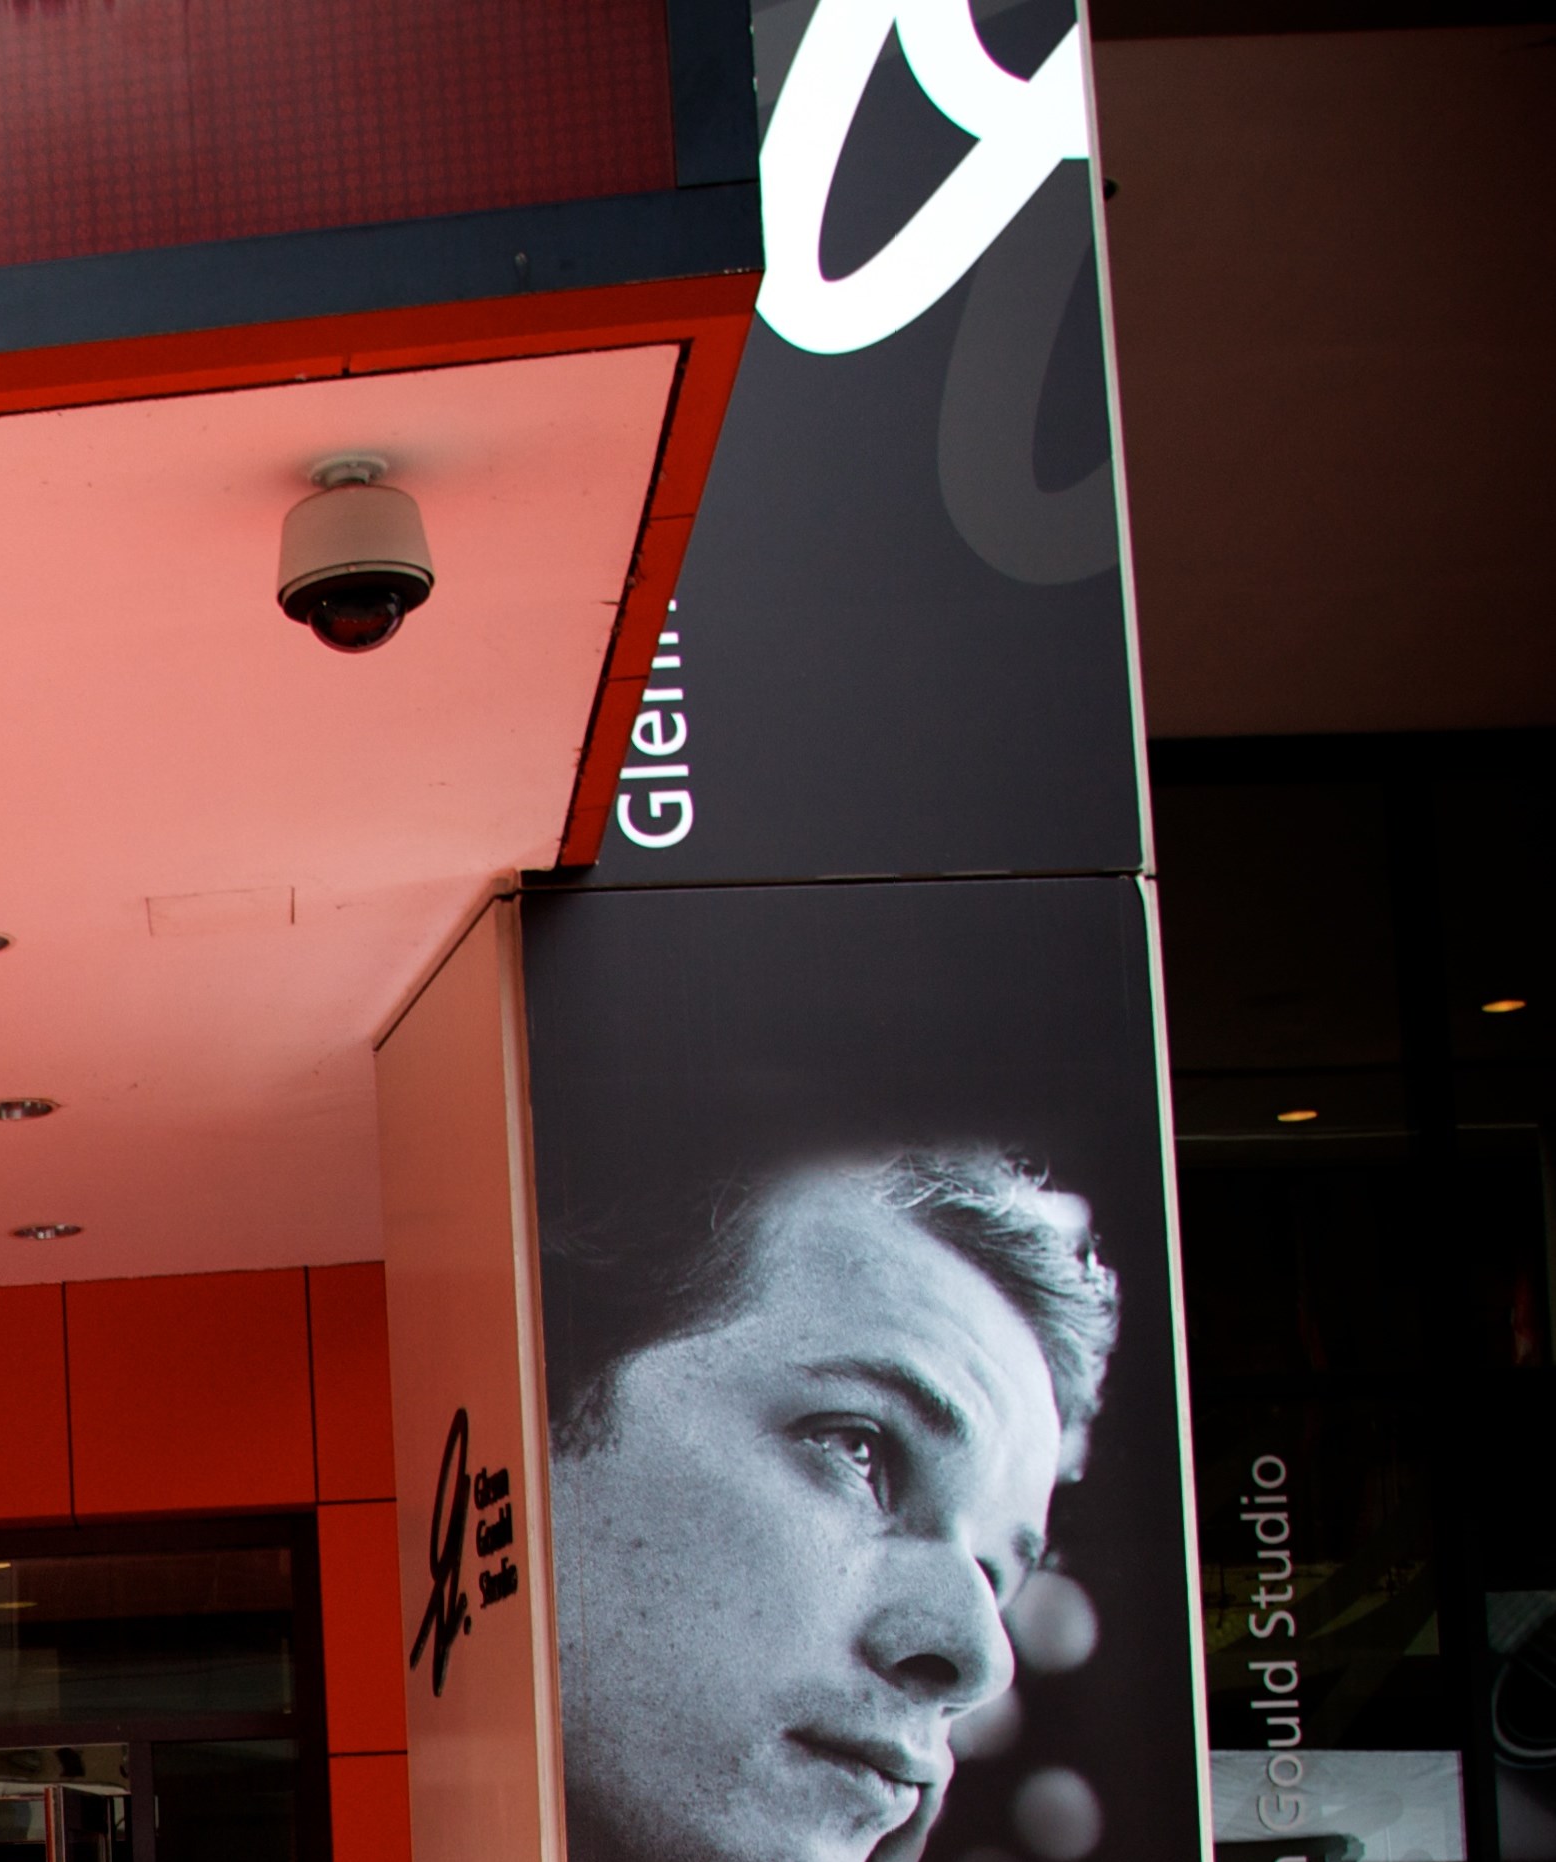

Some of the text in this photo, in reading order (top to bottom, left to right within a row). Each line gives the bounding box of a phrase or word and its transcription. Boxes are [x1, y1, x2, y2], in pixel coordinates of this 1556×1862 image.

[616, 599, 694, 849] Glen
[1239, 1452, 1297, 1638] Studio
[1248, 1659, 1304, 1833] Gould
